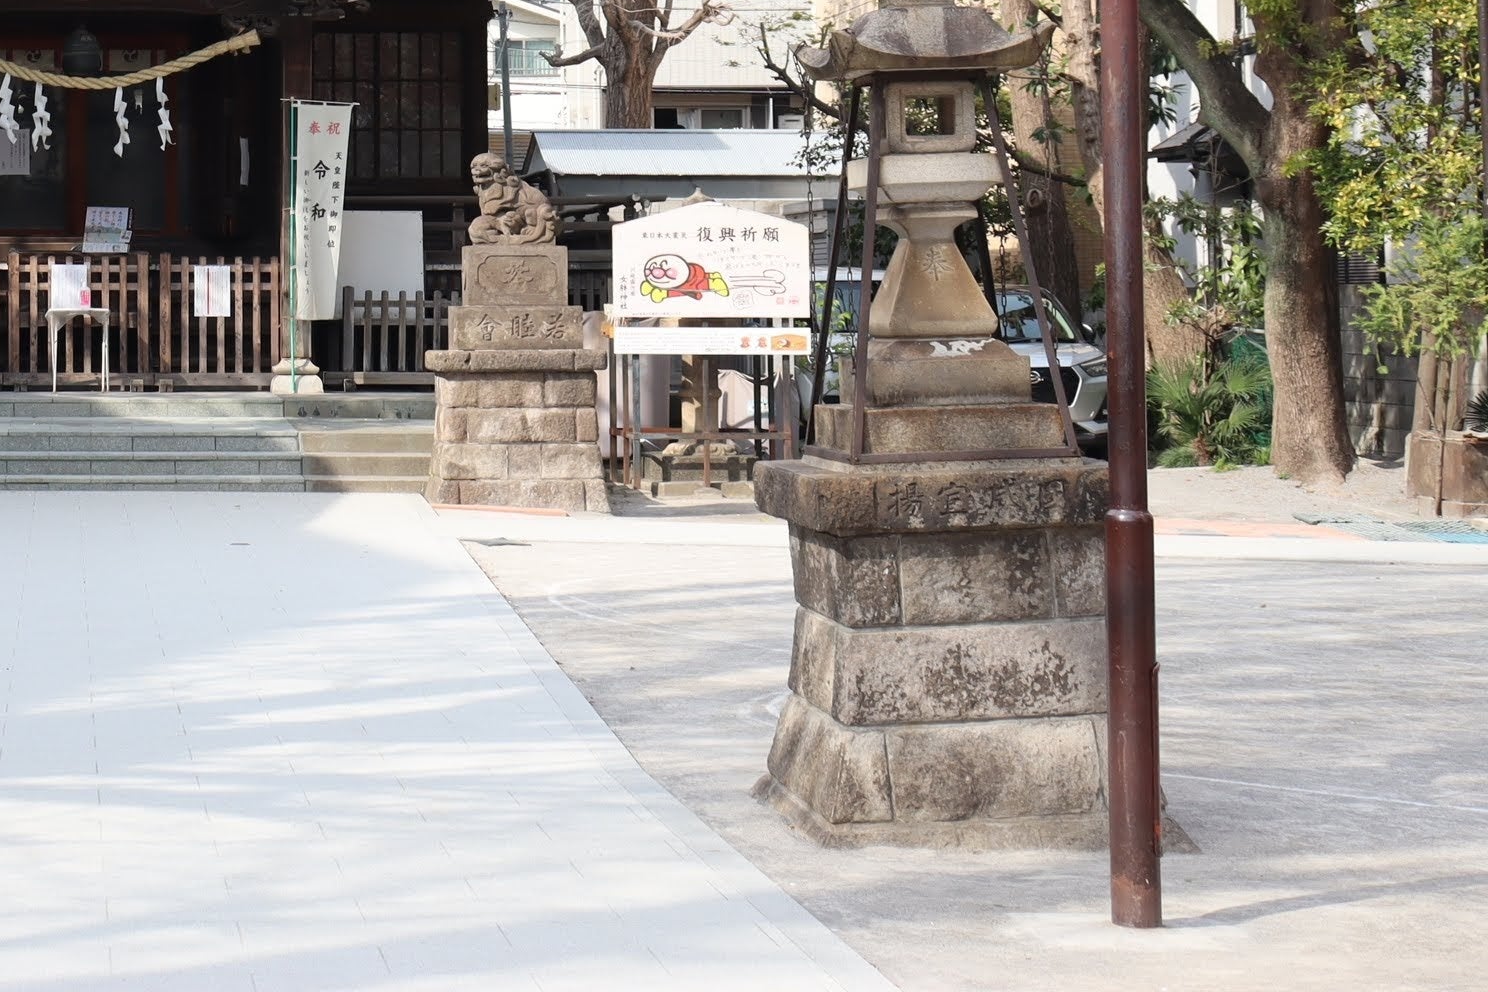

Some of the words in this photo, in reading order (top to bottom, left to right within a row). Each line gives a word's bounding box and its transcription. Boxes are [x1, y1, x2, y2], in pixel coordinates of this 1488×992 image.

[308, 120, 342, 135] 奉祝
[312, 159, 330, 221] 令和
[326, 151, 343, 249] 天皇陛下御即位
[696, 226, 780, 243] 復興祈願
